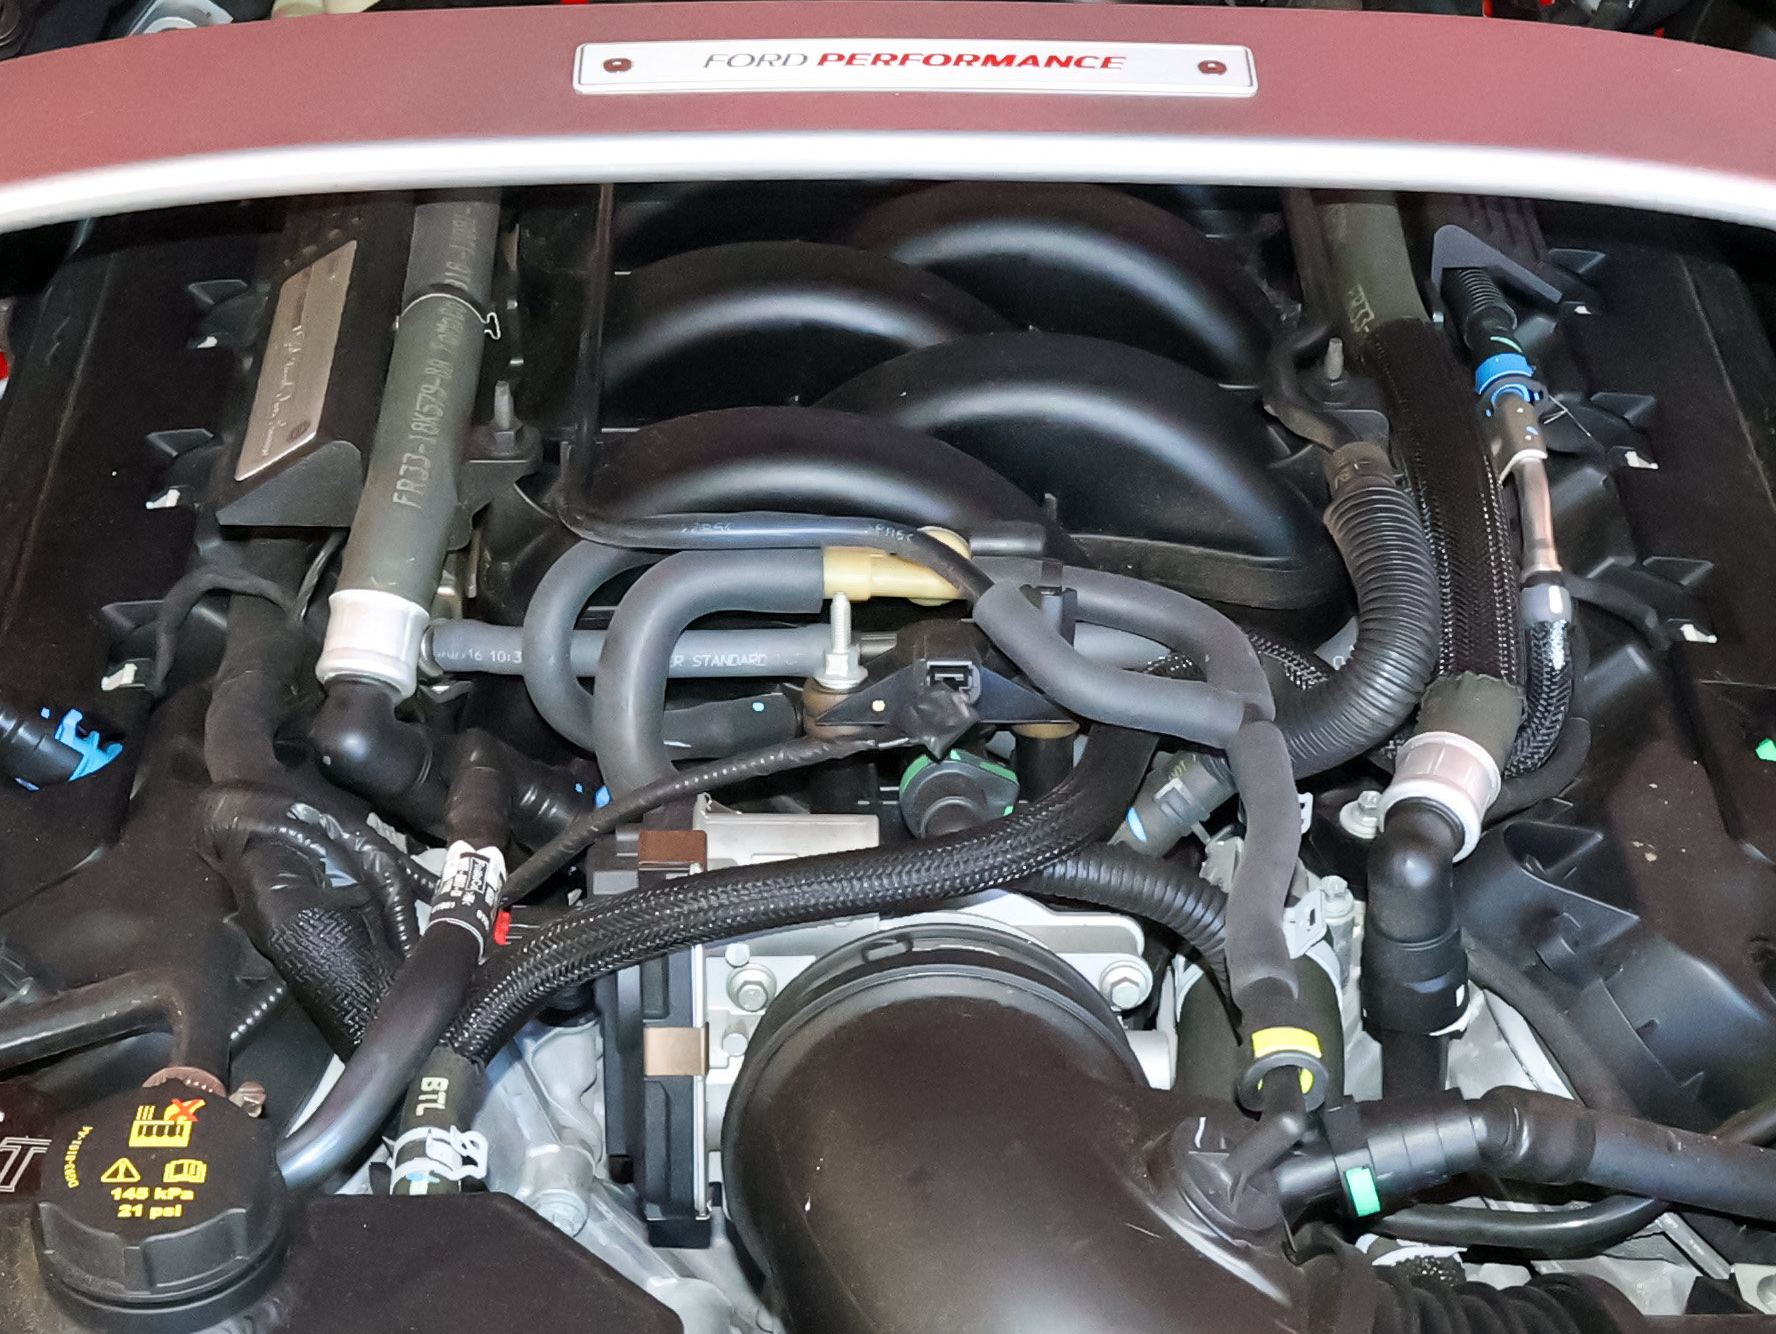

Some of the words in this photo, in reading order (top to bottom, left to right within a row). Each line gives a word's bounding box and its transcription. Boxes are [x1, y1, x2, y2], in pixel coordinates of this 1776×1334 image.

[703, 52, 809, 69] FORD
[816, 51, 1127, 72] PERFORMANCE
[415, 1077, 448, 1116] BTL
[110, 1186, 149, 1201] 145
[153, 1187, 195, 1201] kPa
[117, 1204, 143, 1218] 21
[149, 1204, 183, 1220] psi
